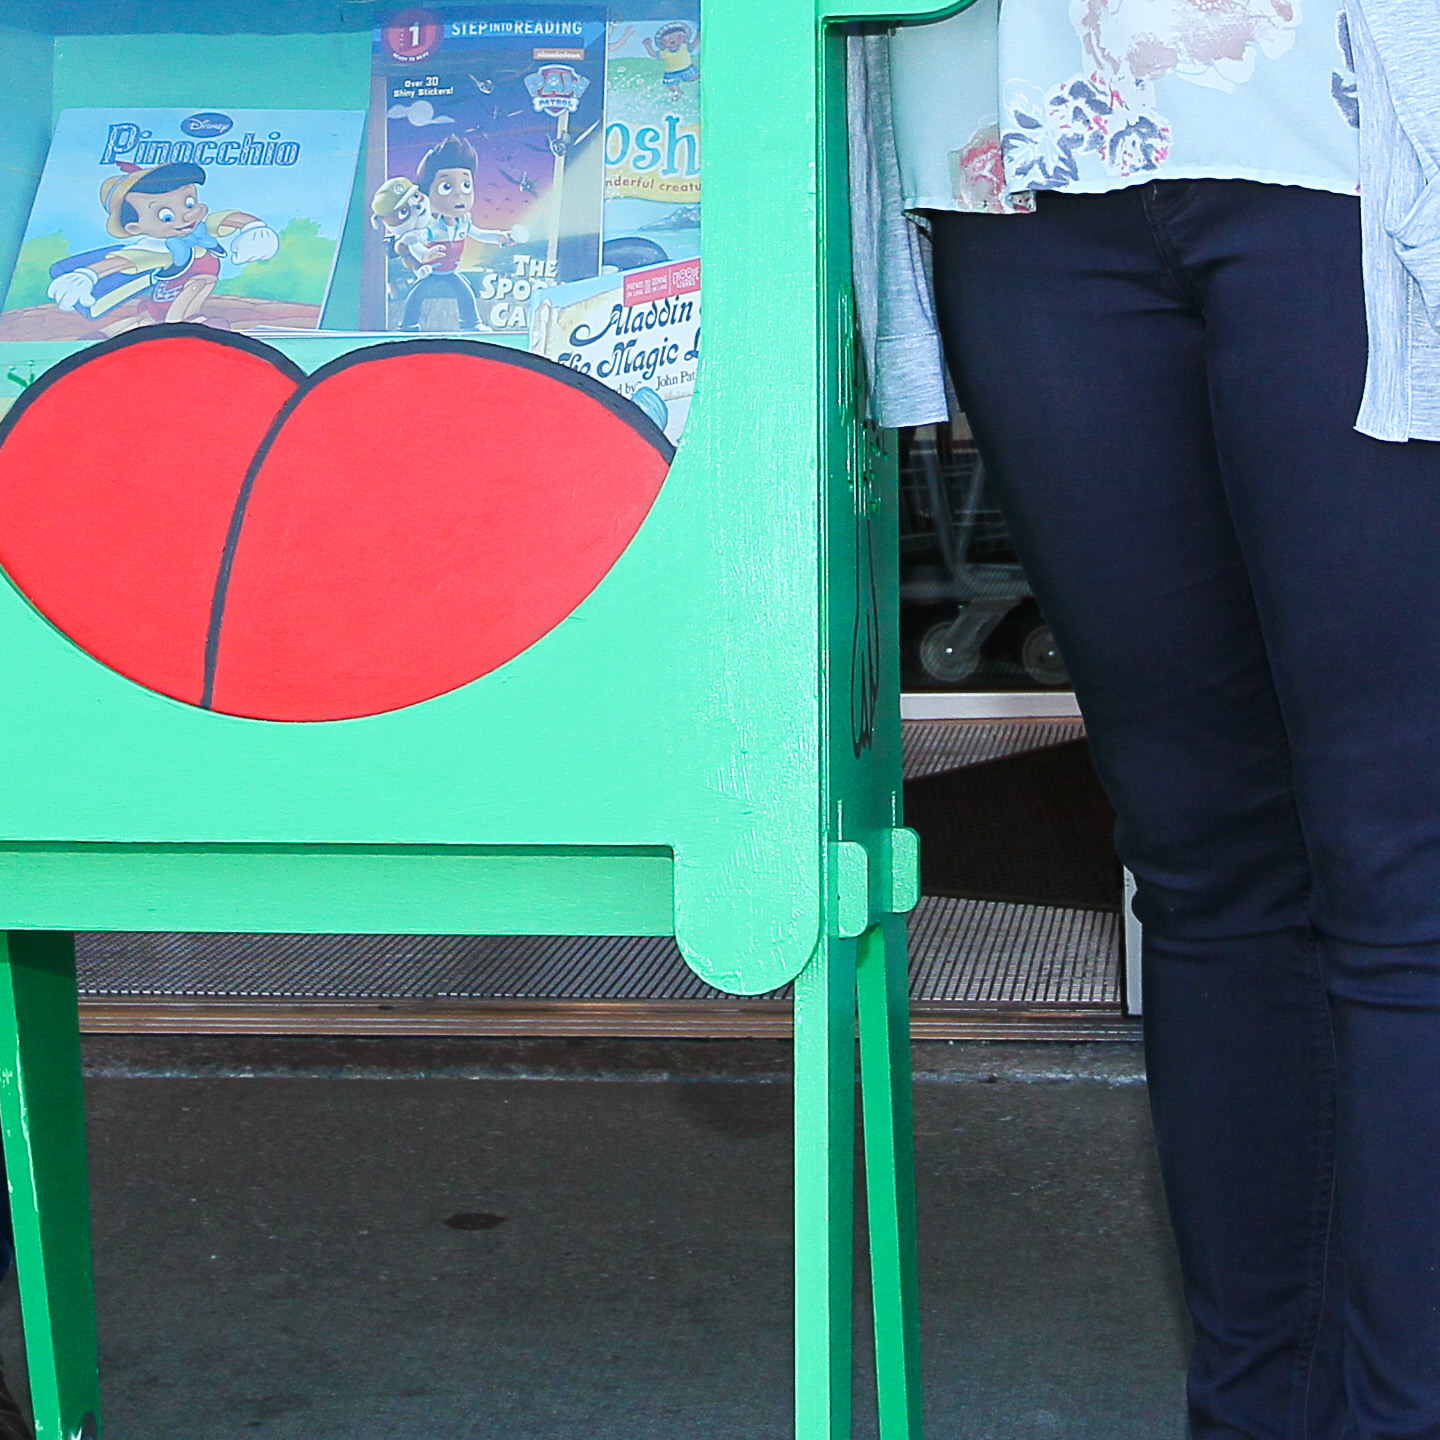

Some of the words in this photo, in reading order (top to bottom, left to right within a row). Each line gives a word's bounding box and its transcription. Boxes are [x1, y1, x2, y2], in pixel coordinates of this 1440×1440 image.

[409, 21, 420, 47] 1
[452, 21, 489, 36] STEP
[489, 21, 512, 33] INTO
[514, 20, 583, 36] READING
[393, 89, 416, 99] Shiny
[404, 80, 424, 88] Over
[188, 117, 231, 134] Disney
[99, 123, 301, 167] Pinocchio
[513, 255, 558, 279] THE
[569, 296, 693, 347] Aladdin
[596, 337, 679, 380] Magic
[656, 374, 678, 391] John
